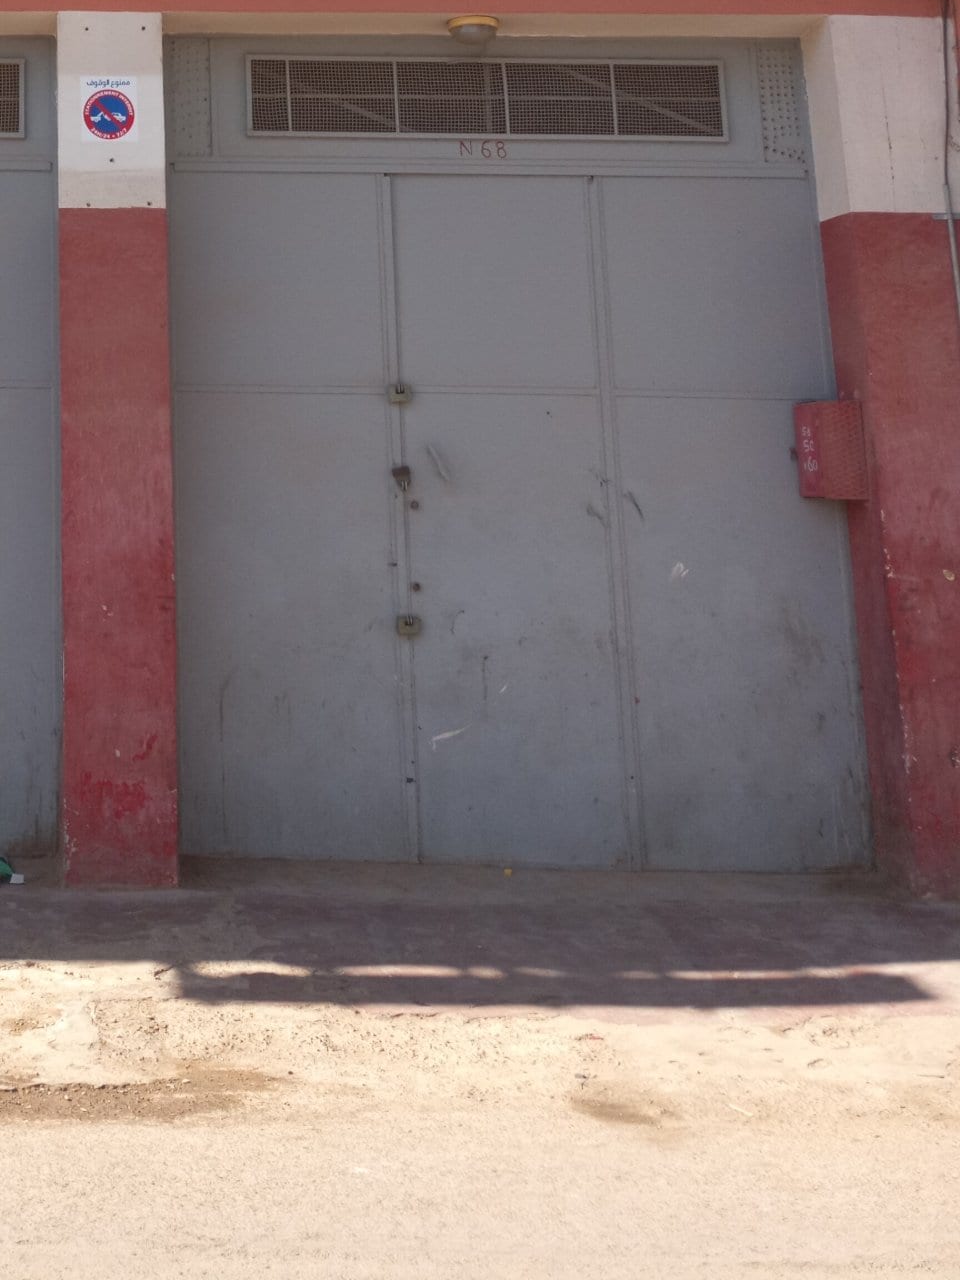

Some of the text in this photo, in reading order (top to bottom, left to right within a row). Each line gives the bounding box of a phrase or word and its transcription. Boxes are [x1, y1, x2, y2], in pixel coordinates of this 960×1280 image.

[86, 79, 131, 89] ممنوع الوقوف
[459, 140, 507, 159] N 68
